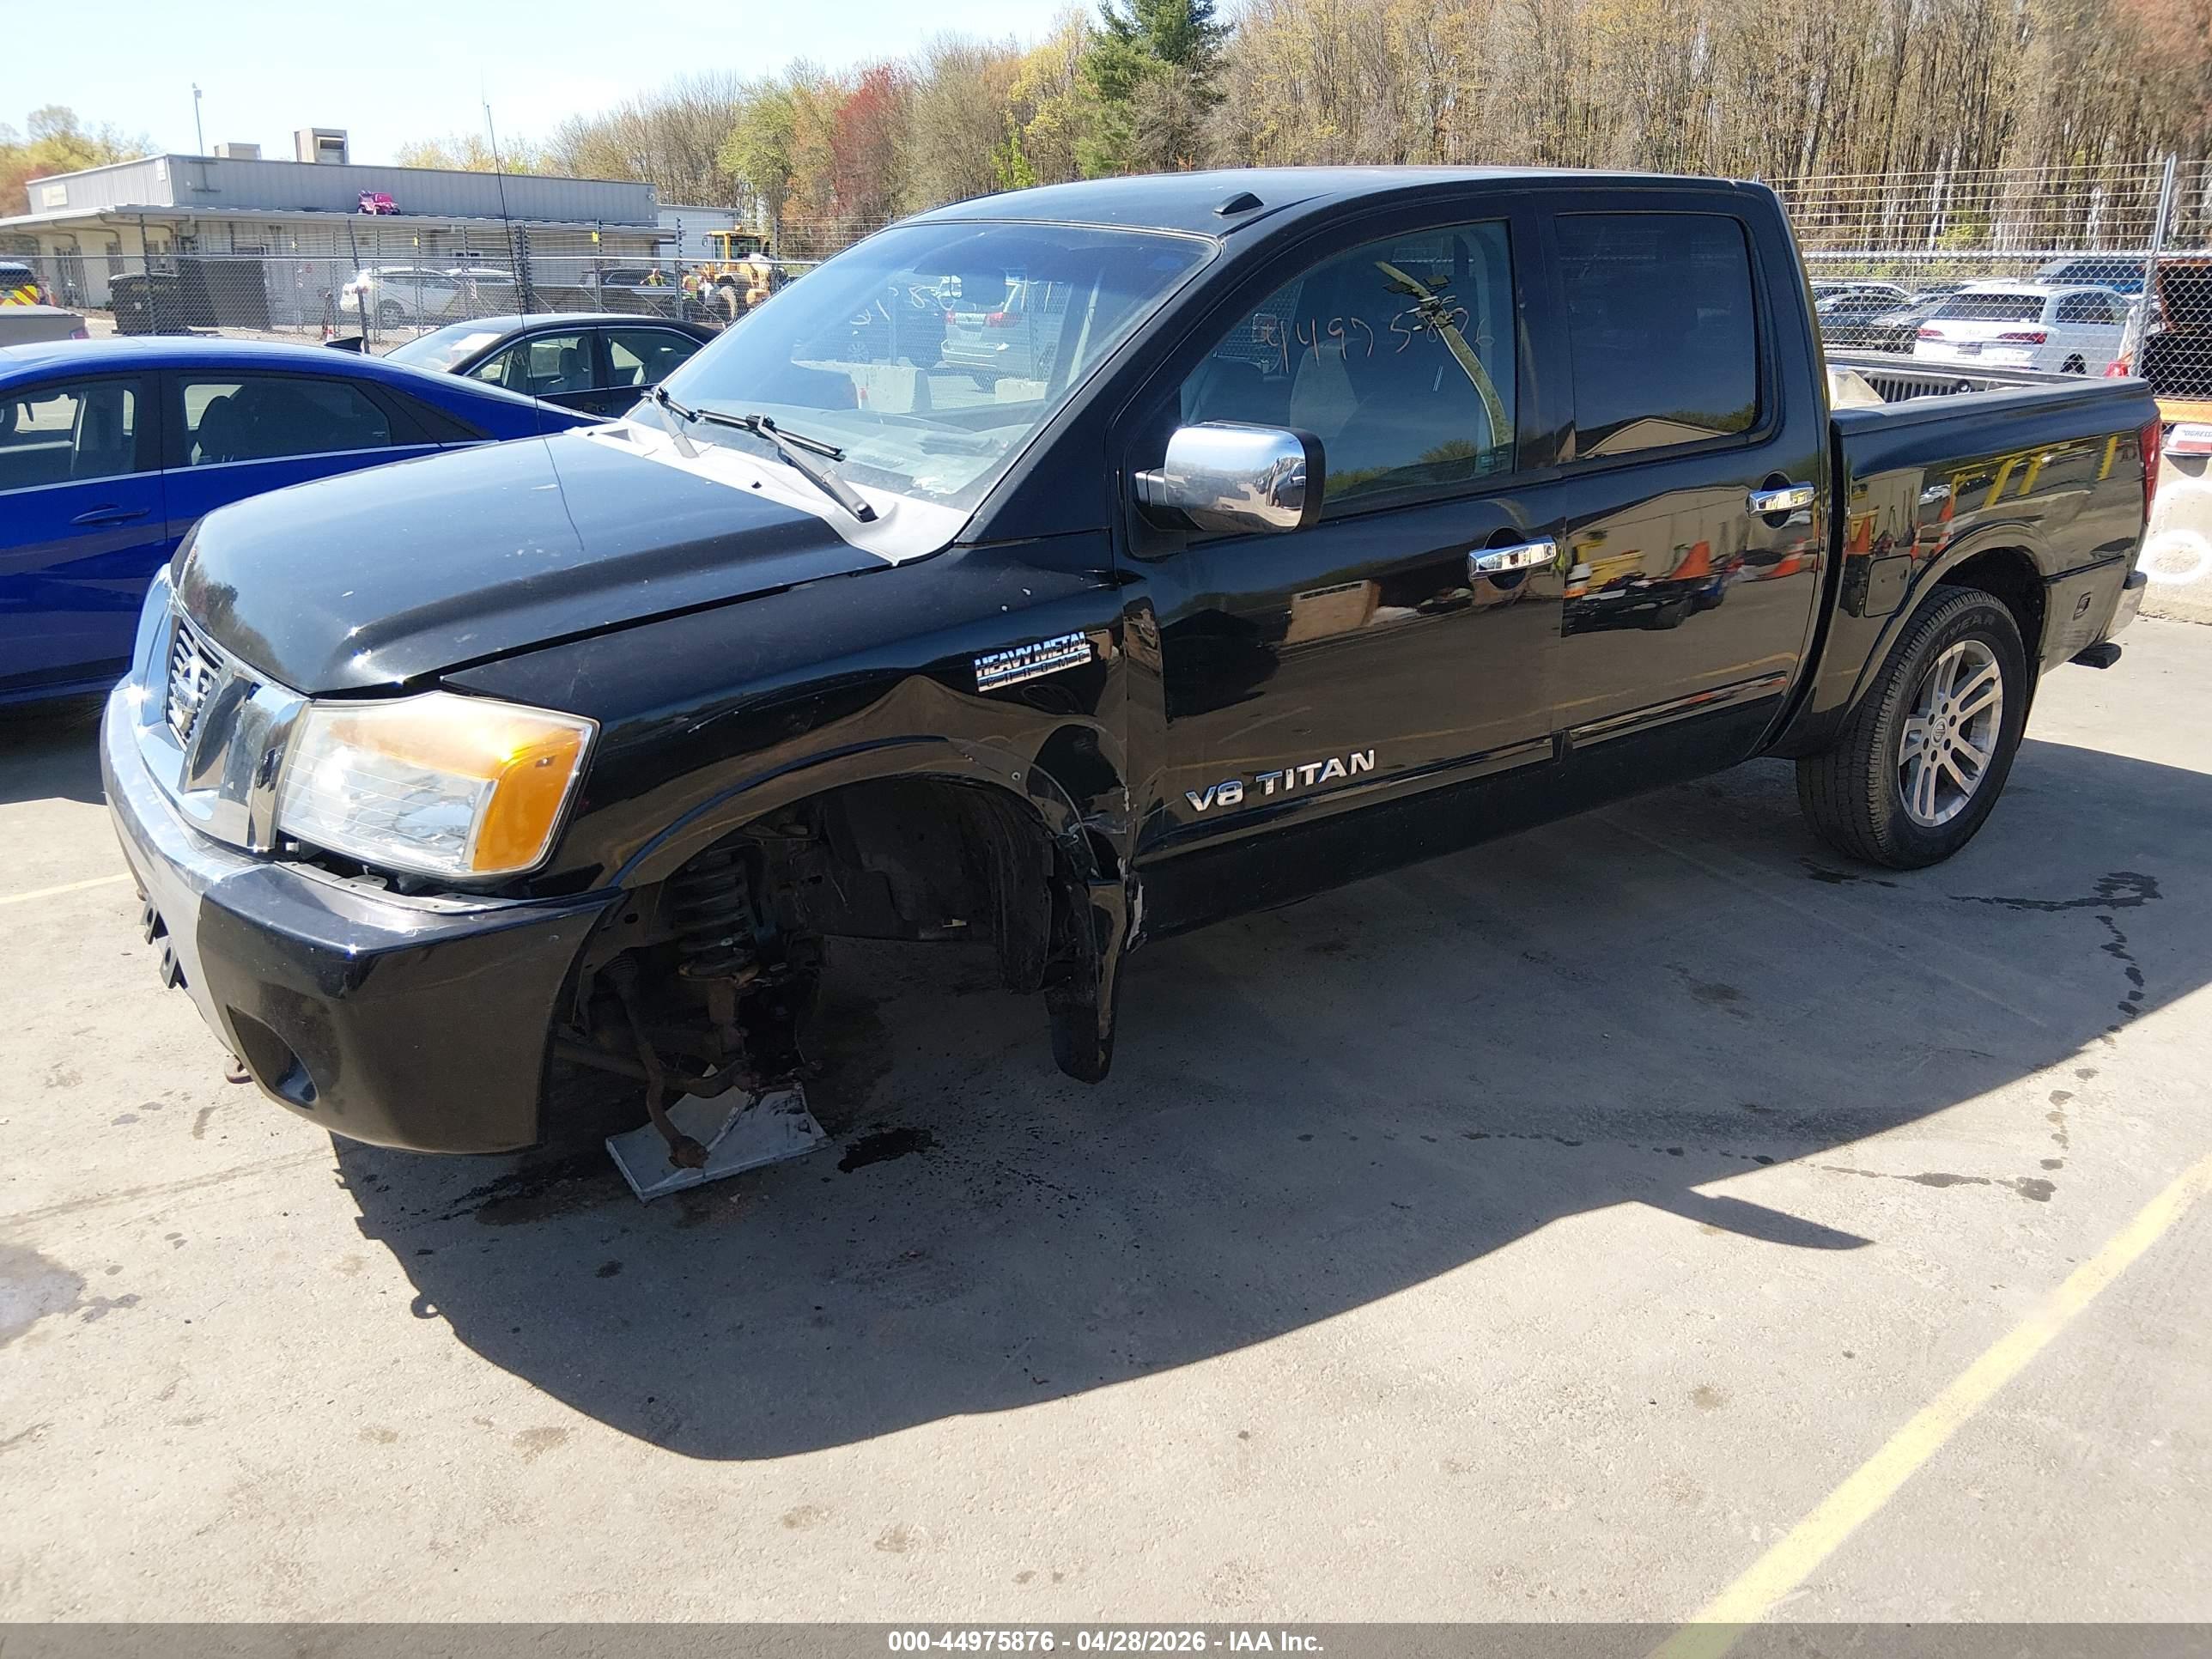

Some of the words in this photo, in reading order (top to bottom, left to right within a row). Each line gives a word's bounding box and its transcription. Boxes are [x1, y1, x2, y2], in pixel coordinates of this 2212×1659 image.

[974, 645, 1032, 678] HEAVY
[1032, 631, 1091, 662] METAL
[1185, 780, 1244, 812] V8
[1255, 749, 1376, 797] TITAN
